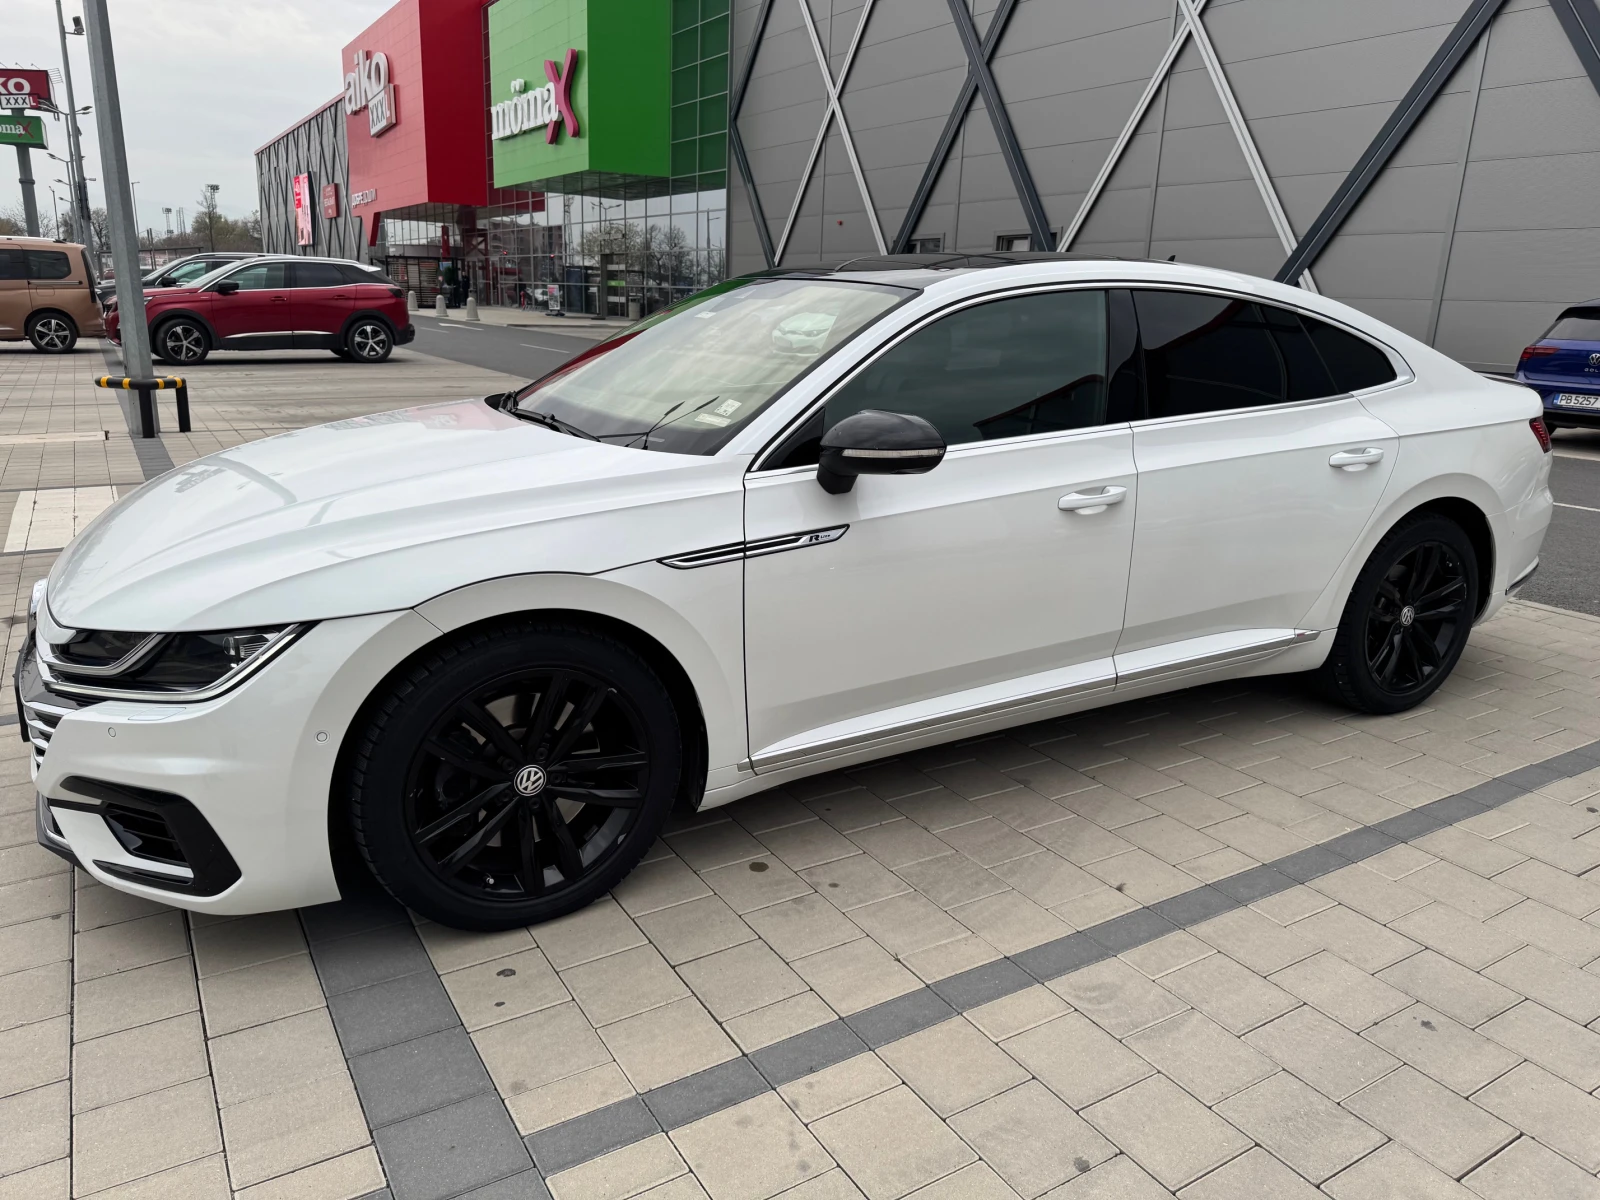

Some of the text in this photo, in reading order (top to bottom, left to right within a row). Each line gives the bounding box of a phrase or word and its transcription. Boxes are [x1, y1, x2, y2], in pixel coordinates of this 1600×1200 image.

[345, 49, 388, 115] aiko
[4, 96, 37, 107] XXXL
[1559, 394, 1599, 407] PB 5257
